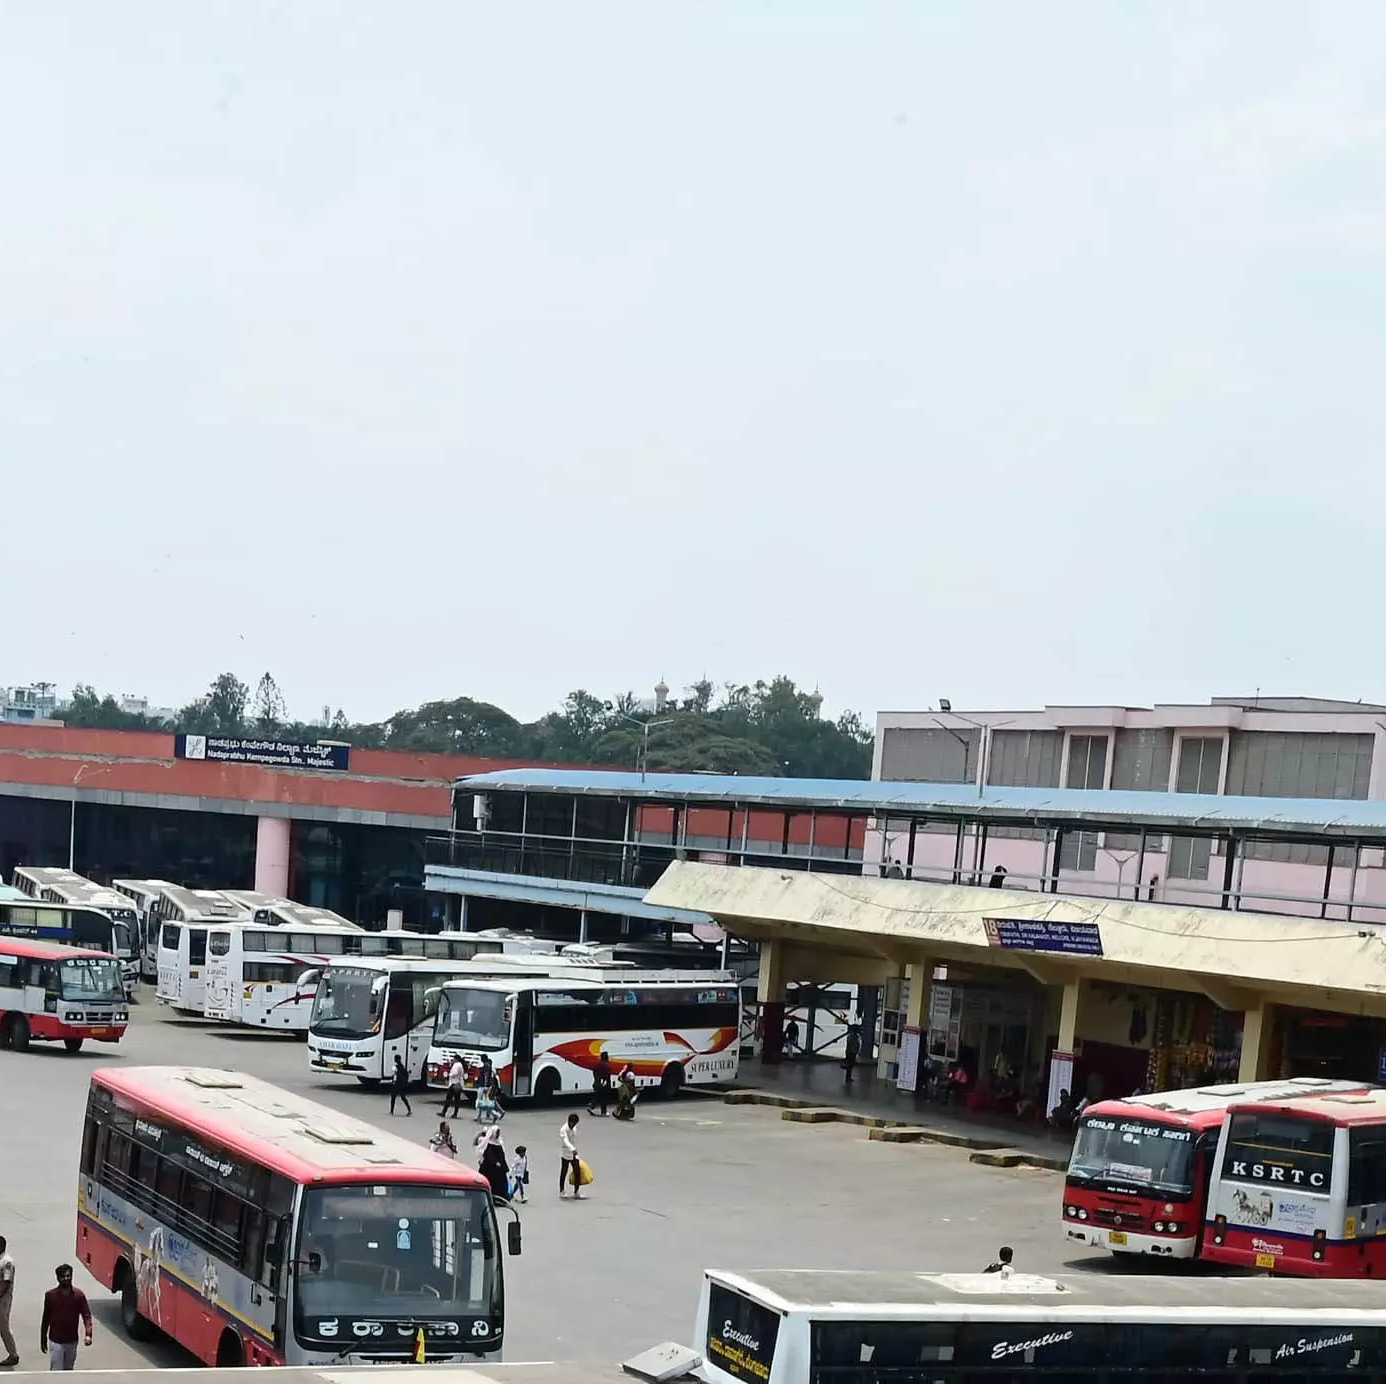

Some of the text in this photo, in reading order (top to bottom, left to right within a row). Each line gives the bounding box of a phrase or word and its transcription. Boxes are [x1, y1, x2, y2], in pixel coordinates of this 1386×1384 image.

[984, 919, 997, 935] 18
[722, 1319, 760, 1351] Executive
[991, 1328, 1073, 1360] Executive
[1275, 1332, 1354, 1360] Air Suspension
